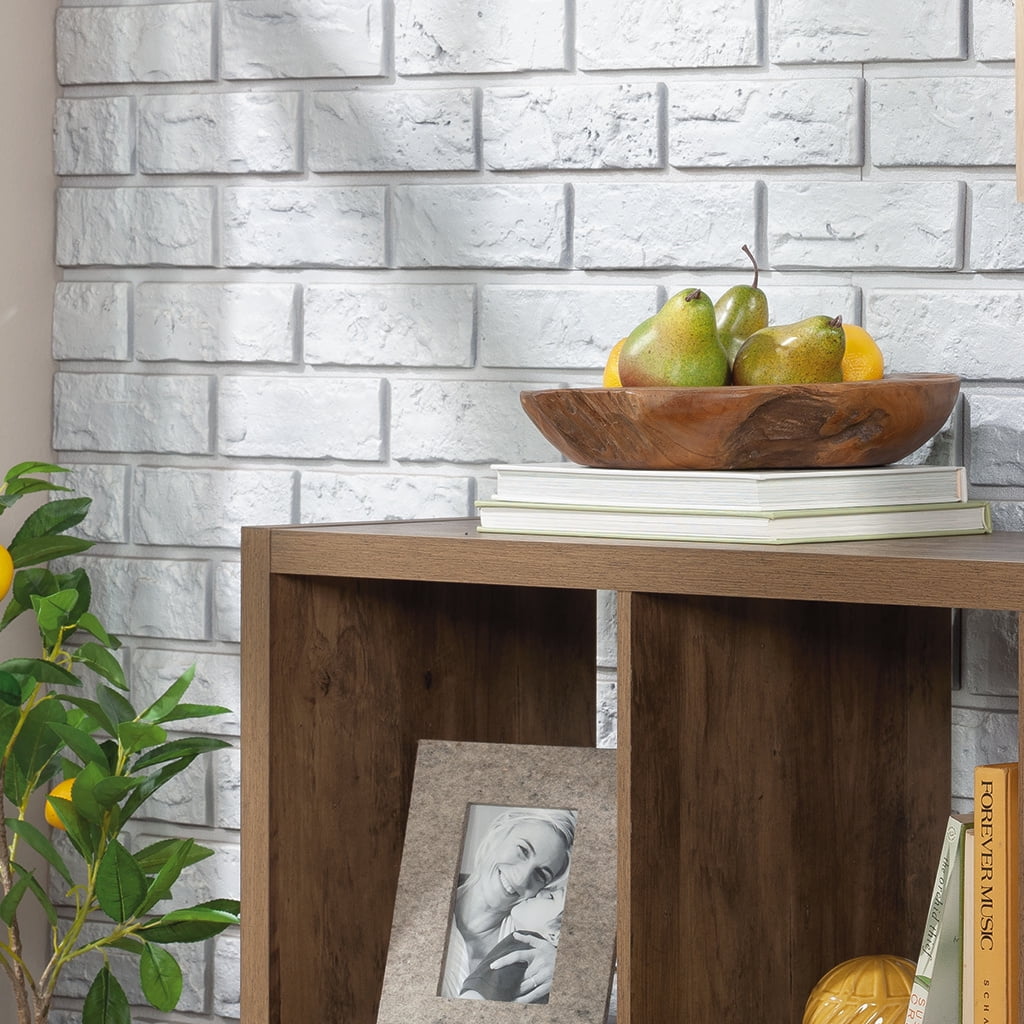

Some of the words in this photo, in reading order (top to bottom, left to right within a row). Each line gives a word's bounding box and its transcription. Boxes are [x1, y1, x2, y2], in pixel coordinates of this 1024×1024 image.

[980, 780, 993, 881] FOREVER
[940, 856, 950, 874] the
[931, 876, 946, 923] orchid
[980, 886, 993, 951] MUSIC
[922, 923, 938, 961] thief
